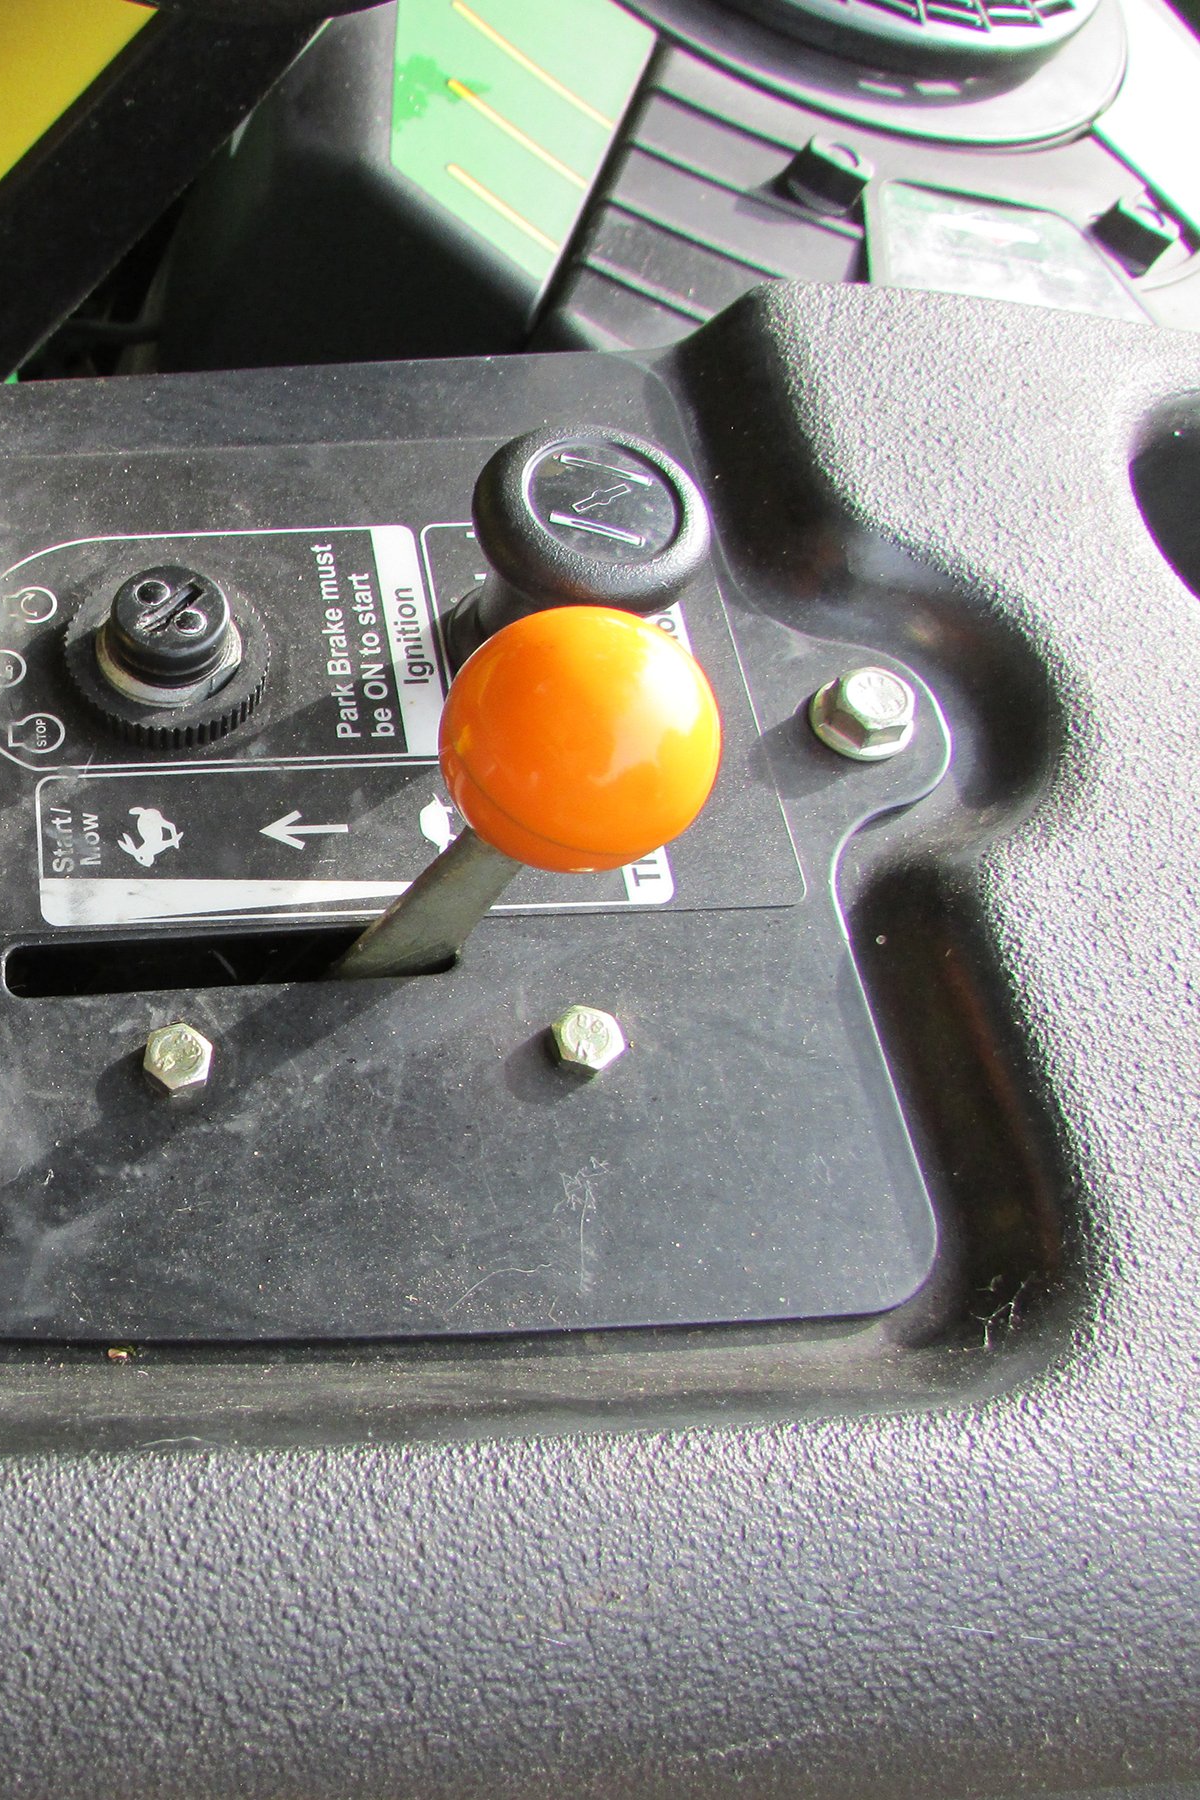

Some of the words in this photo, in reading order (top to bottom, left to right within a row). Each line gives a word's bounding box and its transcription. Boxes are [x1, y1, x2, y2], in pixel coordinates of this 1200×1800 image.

[311, 543, 340, 600] must
[348, 573, 377, 626] start
[322, 607, 351, 675] Brake
[359, 632, 381, 655] to
[393, 587, 434, 685] Ignition
[360, 663, 388, 700] ON
[36, 718, 47, 747] STOP
[331, 683, 361, 739] Park
[371, 708, 395, 738] be
[50, 807, 75, 874] Start/
[80, 812, 101, 866] Mow
